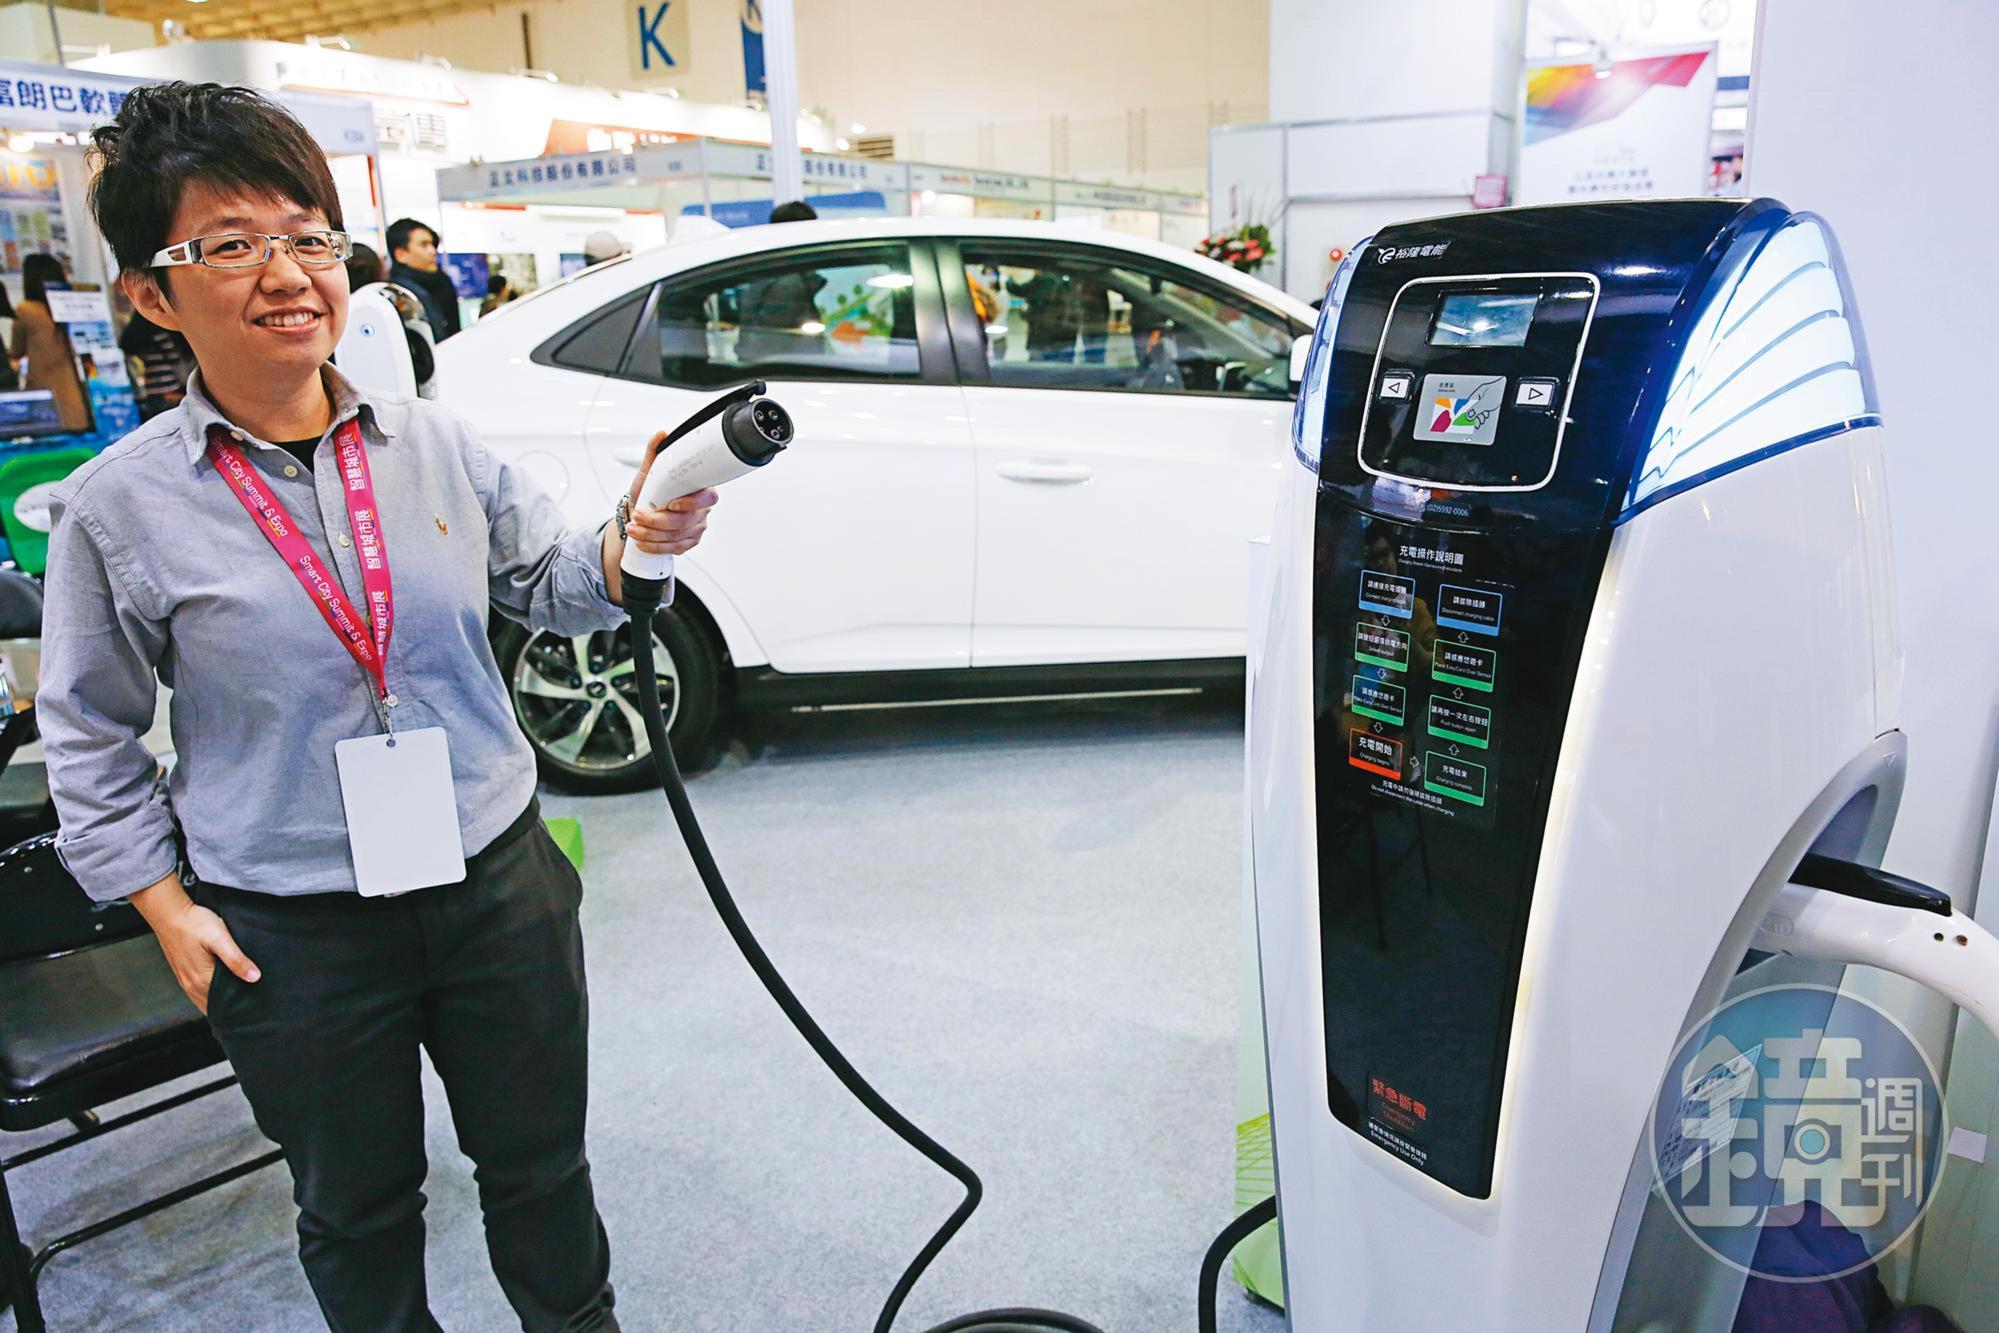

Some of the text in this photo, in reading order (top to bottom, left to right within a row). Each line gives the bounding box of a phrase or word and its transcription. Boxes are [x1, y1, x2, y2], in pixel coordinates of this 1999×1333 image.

[638, 2, 675, 69] K
[211, 436, 288, 537] Smart City Summit & Expo
[339, 434, 365, 491] 智慧城市展
[355, 509, 381, 570] 智慧城市展
[1400, 545, 1464, 566] 充電操作說明圖
[300, 555, 372, 660] Smart City Summit & Expo
[1359, 737, 1392, 756] 充電開始
[1372, 1078, 1427, 1120] 緊急斷電
[1371, 1130, 1424, 1166] Emergency Use Only
